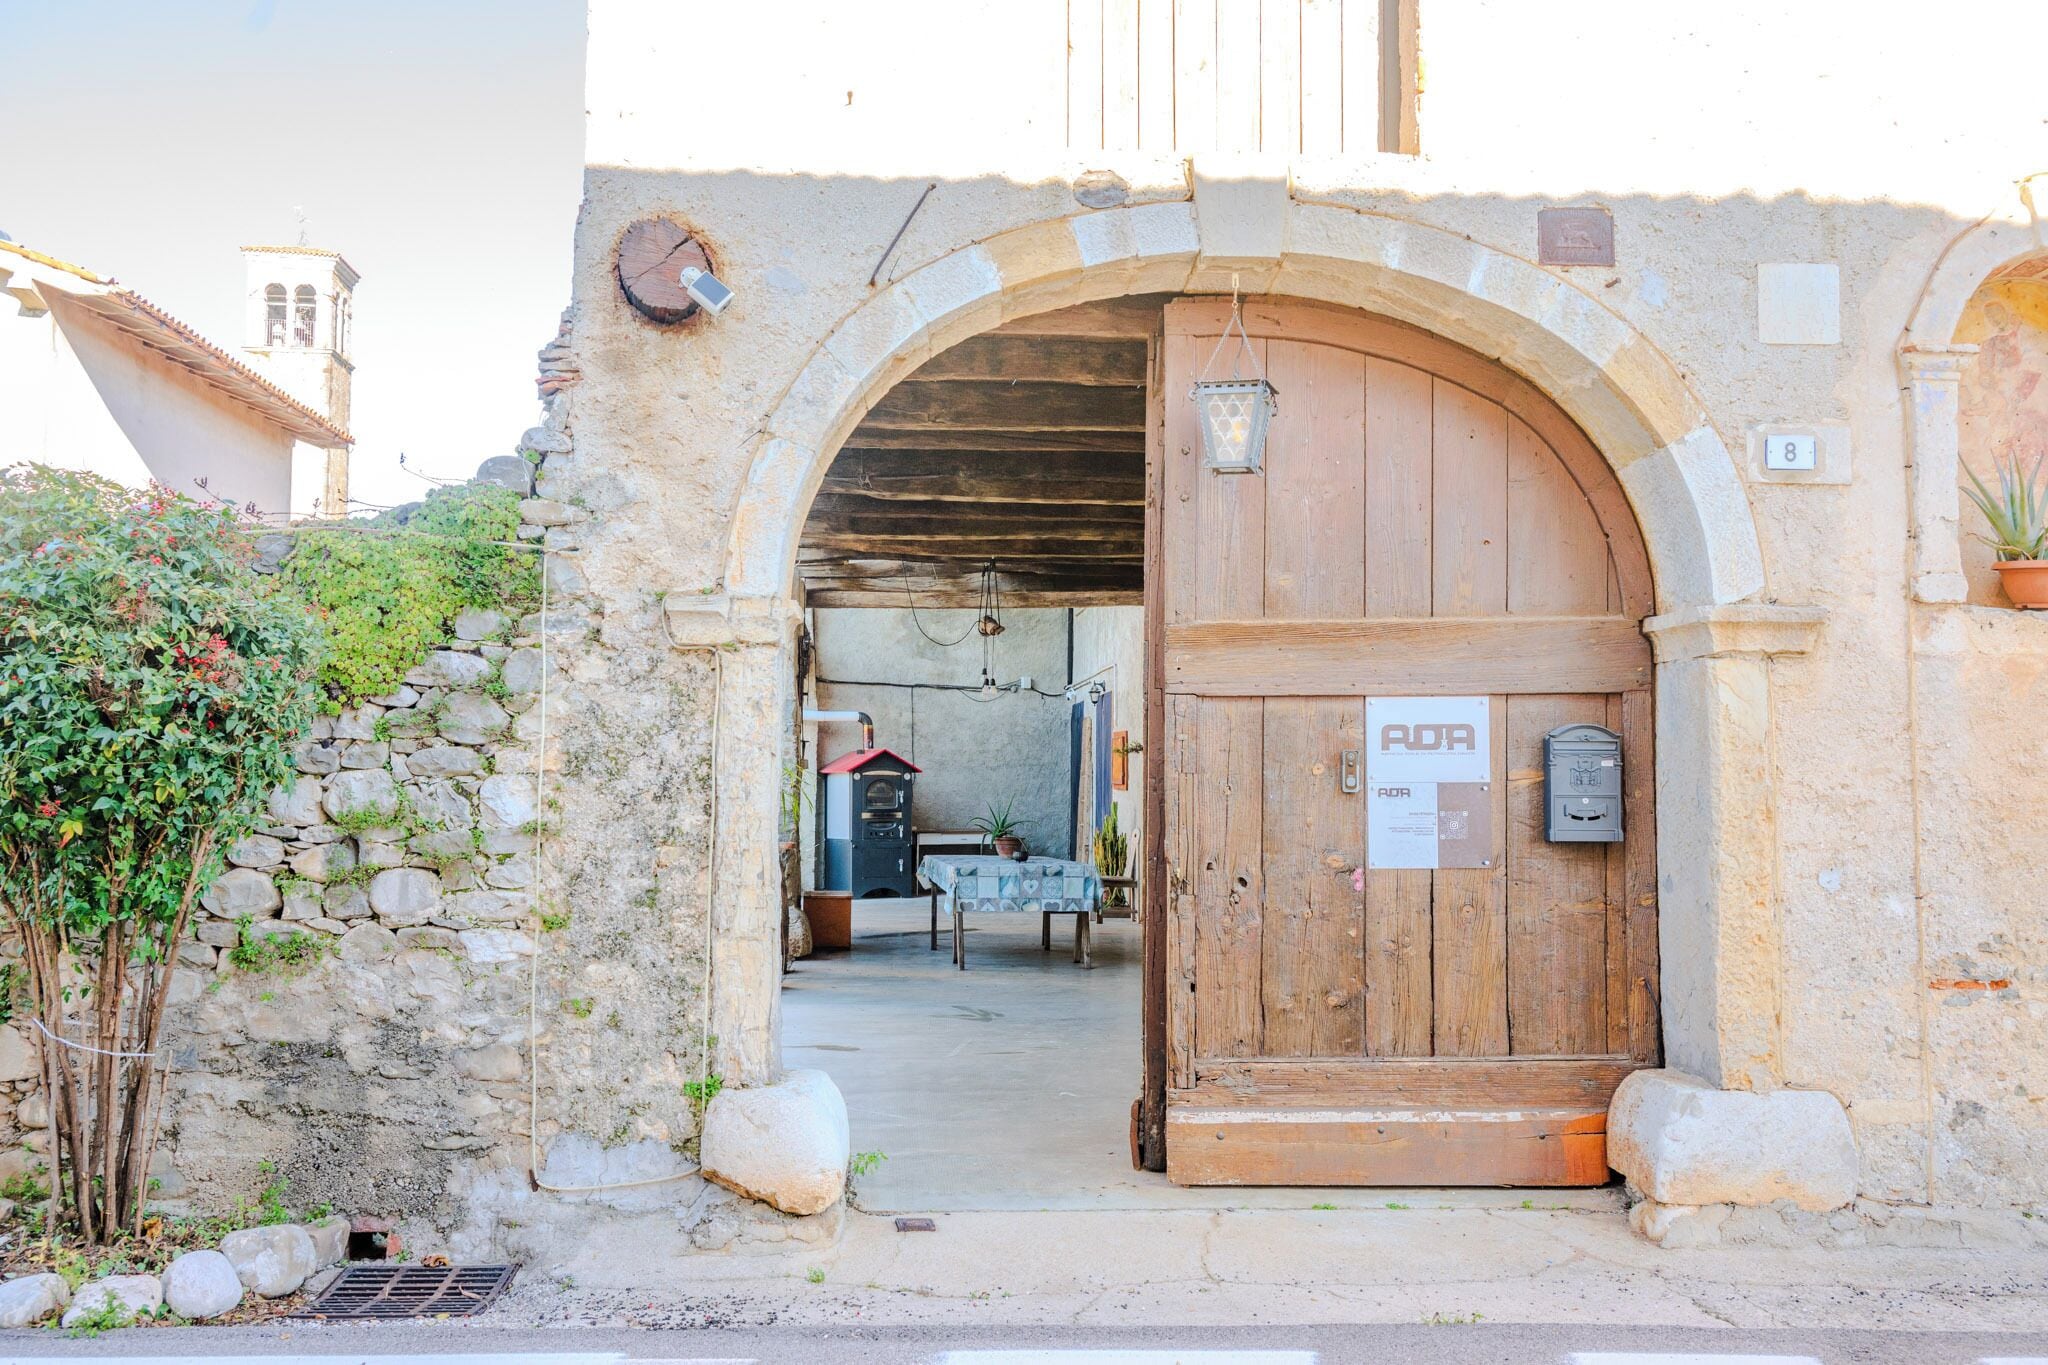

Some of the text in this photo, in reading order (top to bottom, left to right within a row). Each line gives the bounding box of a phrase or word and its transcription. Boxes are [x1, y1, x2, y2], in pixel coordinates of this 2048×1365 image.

[1785, 442, 1797, 462] 8
[1381, 724, 1475, 751] ADA
[1378, 788, 1410, 797] ADA
